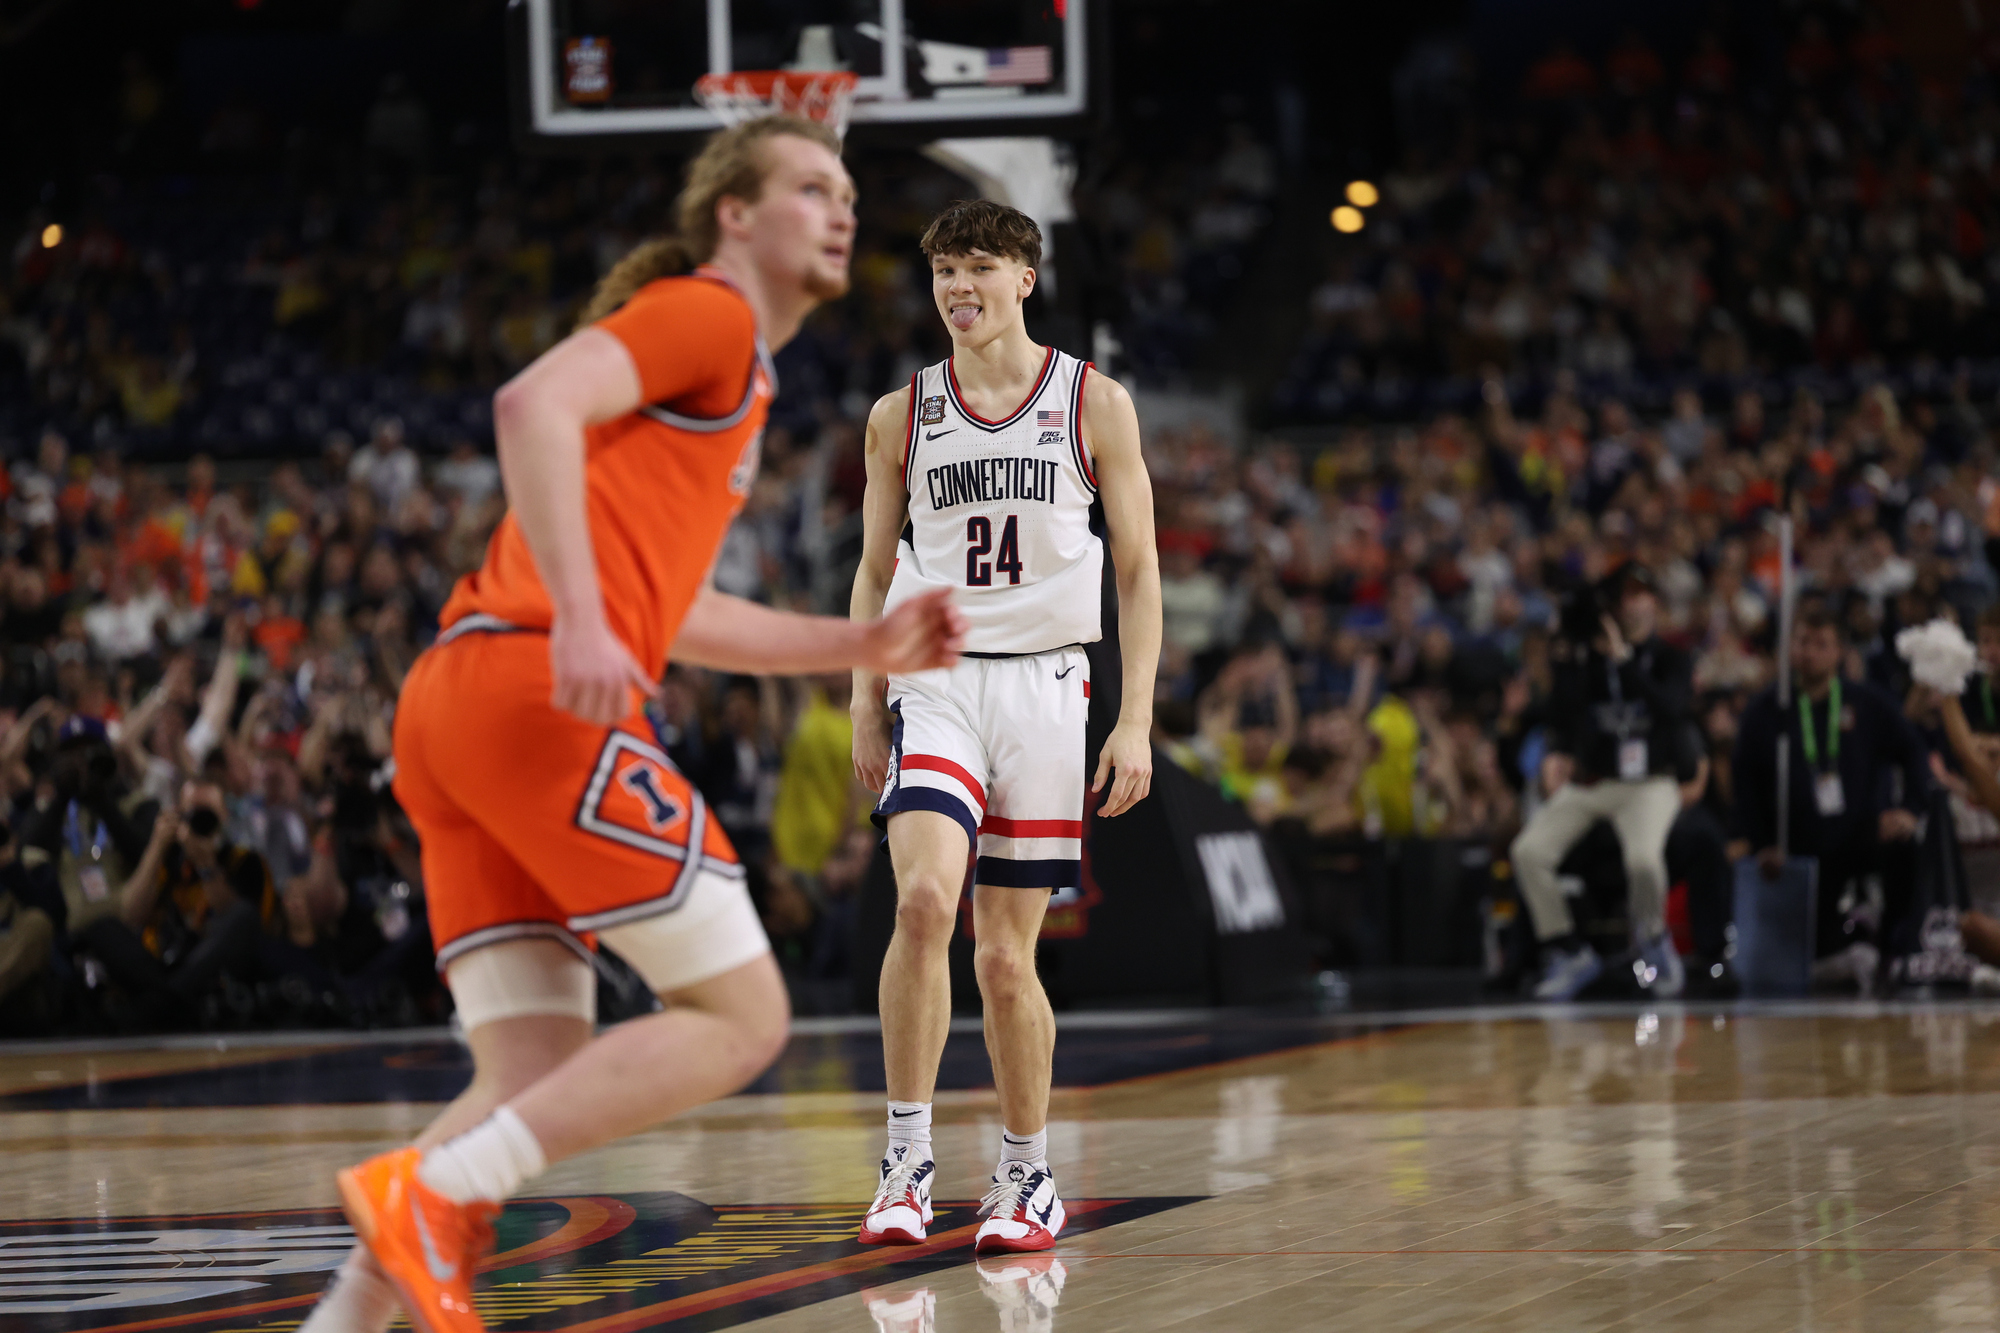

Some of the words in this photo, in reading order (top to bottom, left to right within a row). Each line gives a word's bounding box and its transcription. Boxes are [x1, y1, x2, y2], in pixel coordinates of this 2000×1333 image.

[924, 412, 941, 420] FOUR
[925, 400, 942, 408] FINAL
[926, 458, 1058, 510] CONNECTICUT
[966, 515, 1023, 586] 24
